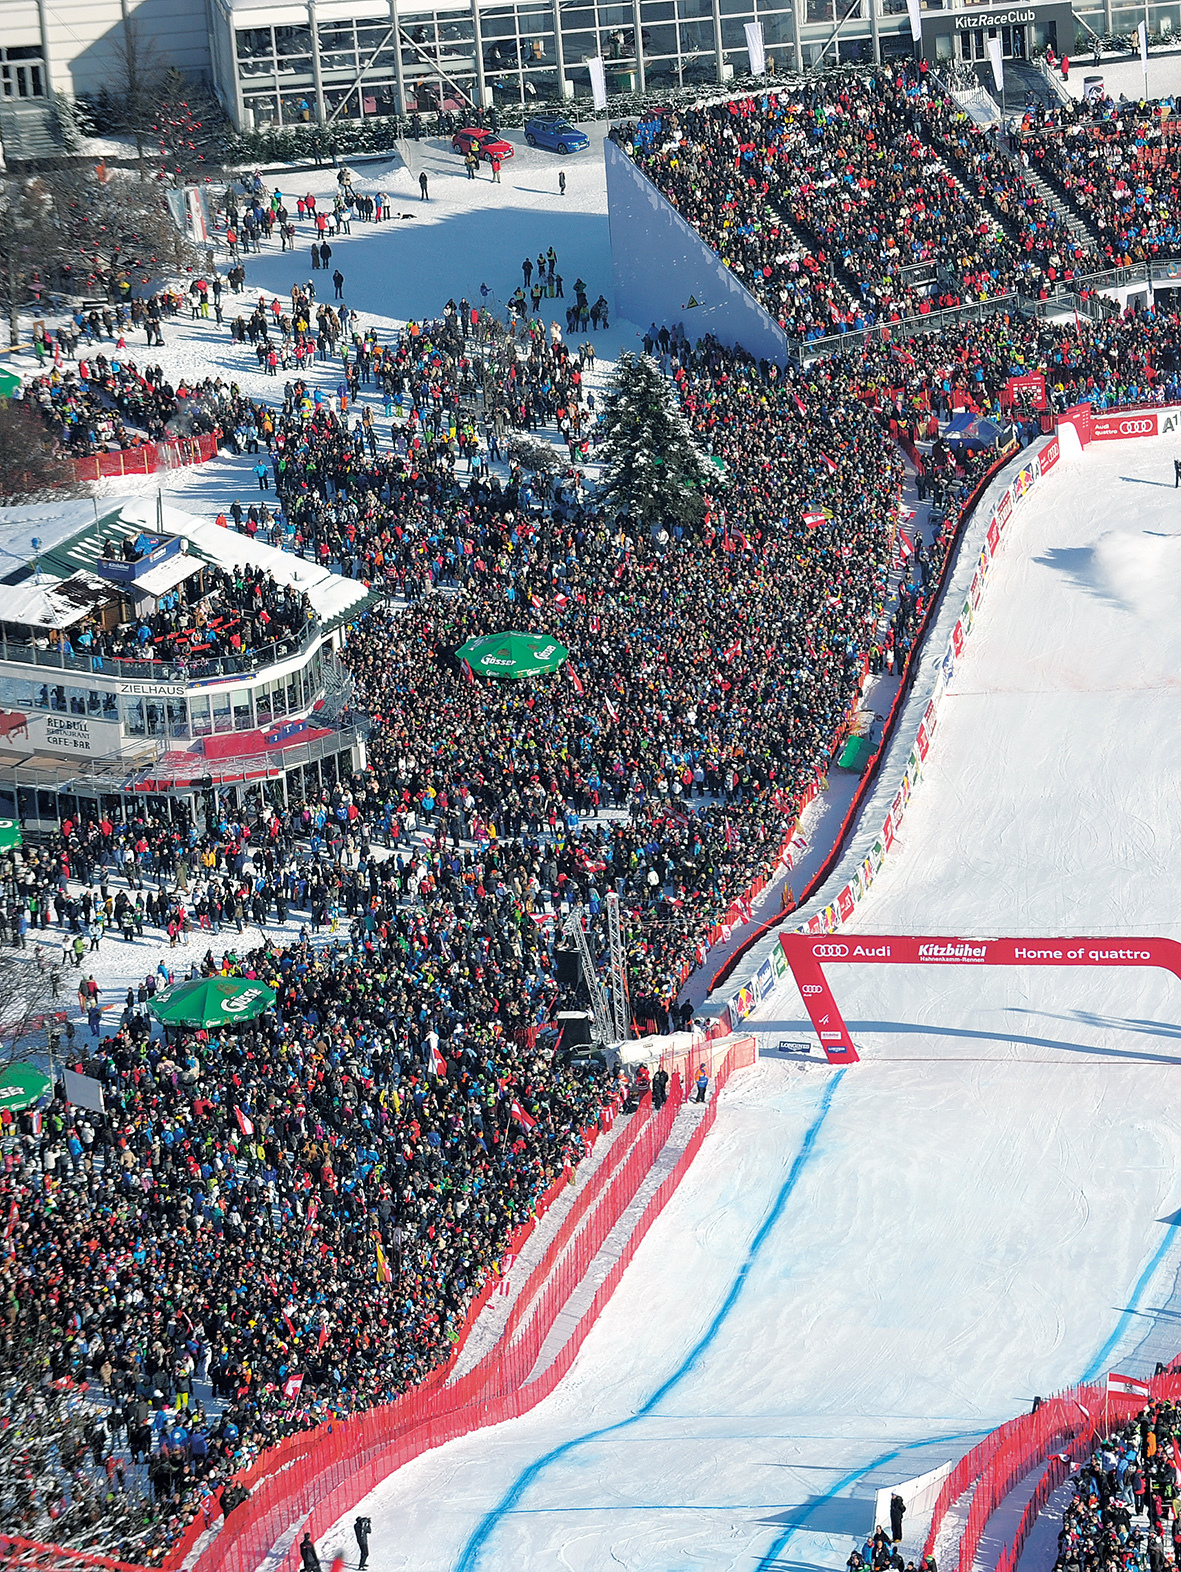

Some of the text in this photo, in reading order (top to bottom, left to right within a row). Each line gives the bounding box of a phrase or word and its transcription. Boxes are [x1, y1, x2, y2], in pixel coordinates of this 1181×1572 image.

[955, 9, 1035, 28] KitzRaceClub
[1162, 414, 1178, 434] A1
[480, 653, 517, 666] Gösser
[120, 684, 185, 696] ZIELHAUS
[47, 717, 89, 733] RED BULL
[46, 727, 90, 740] RESTAURANT
[47, 736, 91, 750] CAFE-BAR
[852, 945, 891, 957] Audi
[918, 943, 987, 957] Kitzbühel
[1014, 947, 1151, 962] Home of quattro
[780, 1042, 810, 1051] LONGINES
